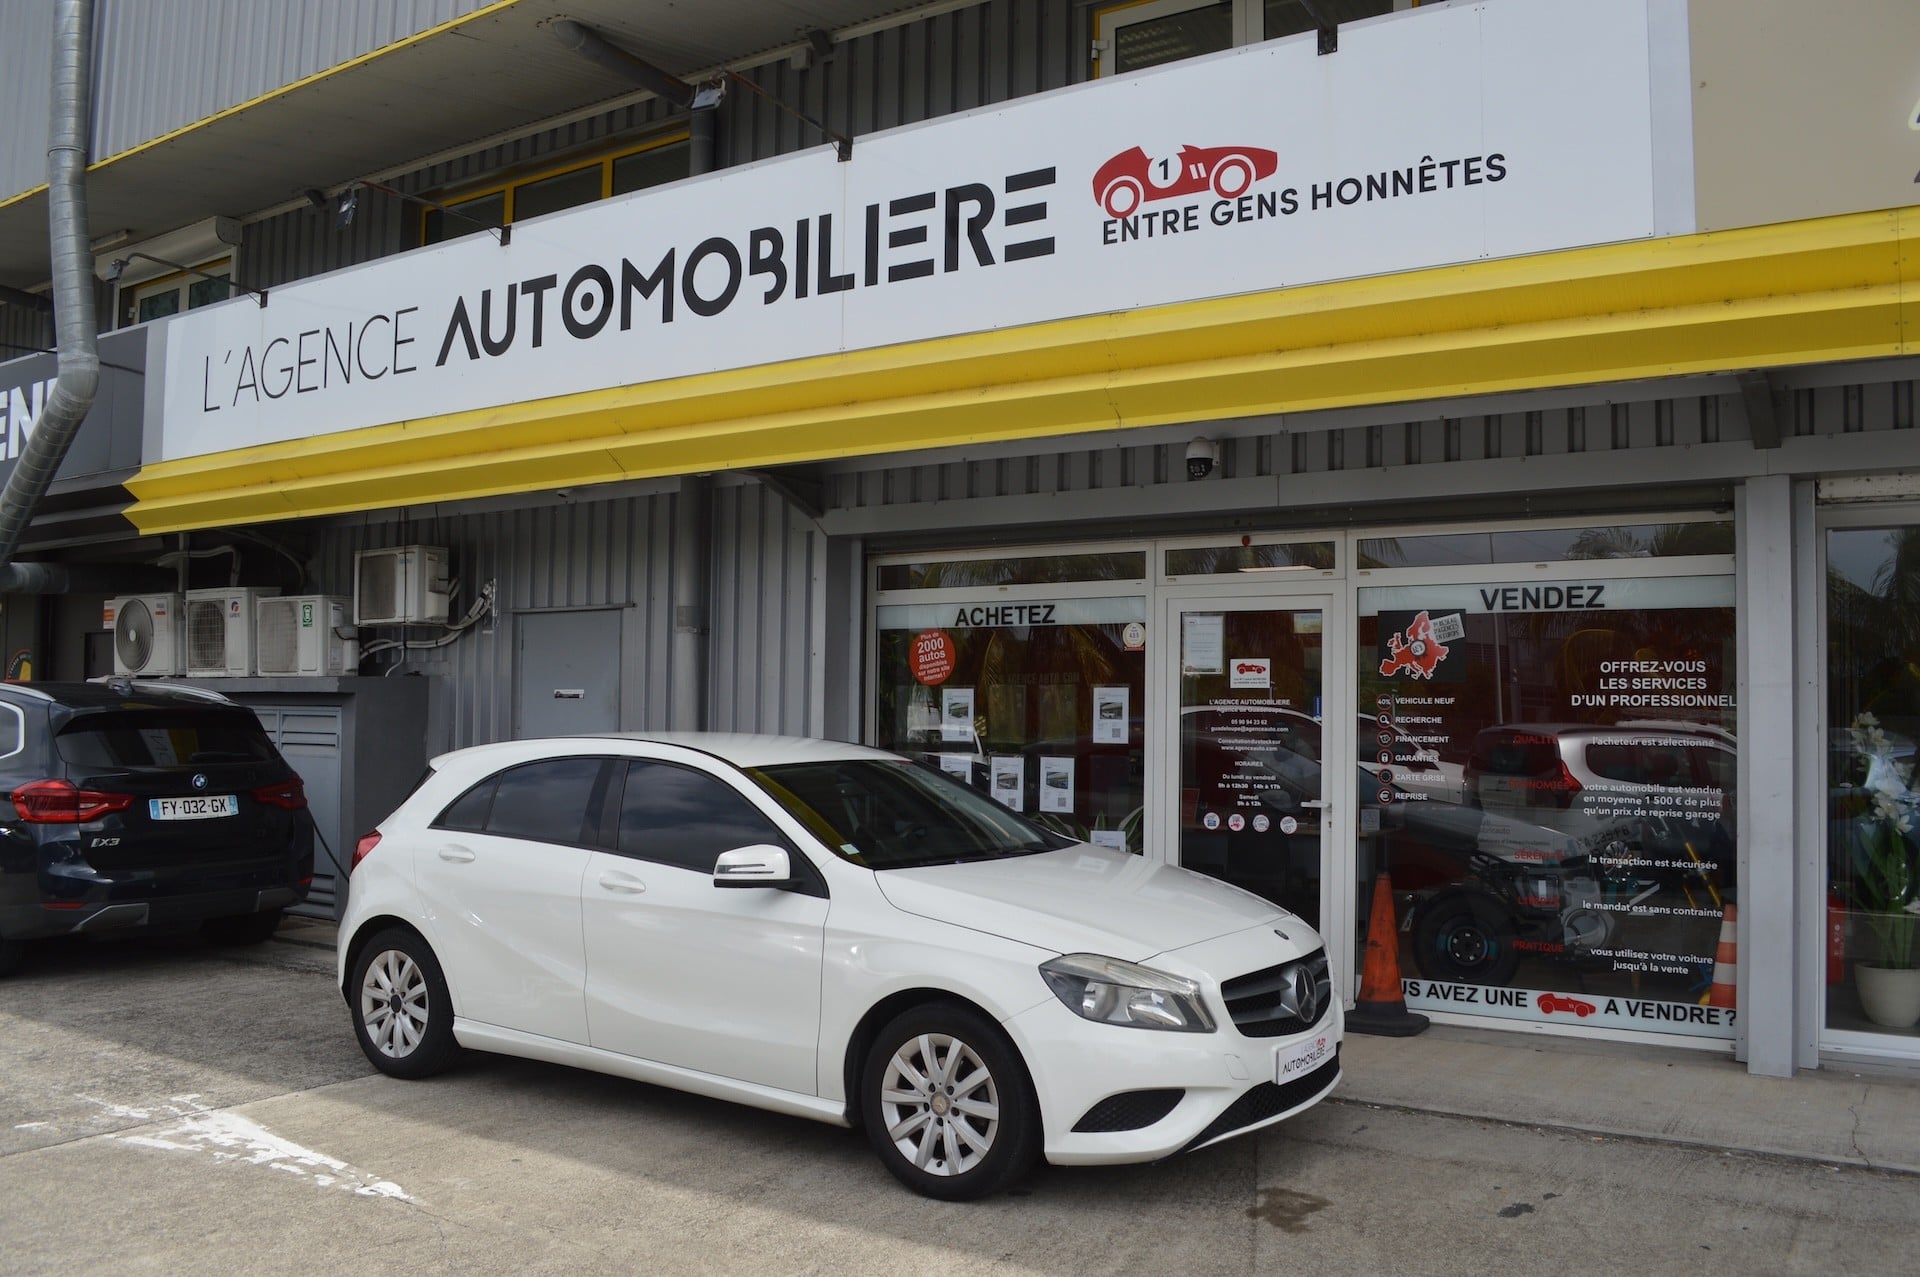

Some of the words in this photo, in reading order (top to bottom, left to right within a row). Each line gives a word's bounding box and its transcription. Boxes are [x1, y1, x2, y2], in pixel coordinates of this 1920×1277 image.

[1103, 204, 1201, 246] ENTRE
[1210, 188, 1299, 226] GENS
[1311, 153, 1508, 212] HONNÊTES
[436, 166, 1056, 368] AUTOMOBILIERE
[1480, 585, 1605, 611] VENDEZ
[955, 604, 1056, 627] ACHETEZ
[917, 637, 944, 655] 2000
[919, 650, 946, 663] autos
[1600, 660, 1707, 673] OFFREZ-VOUS
[1599, 677, 1629, 690] LES
[1631, 677, 1707, 690] SERVICES
[1395, 697, 1433, 705] VEHICULE
[1434, 697, 1456, 705] NEUF
[1609, 694, 1737, 707] PROFESSIONNEL
[1395, 716, 1443, 724] RECHERCHE
[1395, 735, 1450, 744] FINANCEMENT
[1640, 738, 1656, 747] est
[1658, 737, 1715, 748] sélectionné
[1395, 754, 1440, 763] GARANTIES
[1395, 774, 1421, 782] CARTE
[1422, 774, 1446, 782] GRISE
[1583, 784, 1608, 792] votre
[1609, 784, 1665, 793] automobile
[1685, 786, 1722, 795] vendue
[1395, 792, 1428, 801] REPRISE
[1597, 796, 1642, 806] moyenne
[1653, 796, 1673, 806] 500
[1675, 797, 1683, 806] €
[1684, 797, 1698, 806] de
[1699, 798, 1721, 809] plus
[161, 799, 227, 816] FY-032-GX
[1612, 809, 1632, 818] prix
[1633, 808, 1647, 817] de
[1648, 808, 1683, 820] reprise
[1684, 810, 1721, 821] garage
[1588, 854, 1598, 864] la
[1599, 856, 1653, 869] transaction
[1654, 859, 1670, 867] est
[1671, 860, 1718, 870] sécurisée
[1582, 900, 1592, 909] le
[1593, 902, 1631, 912] mandat
[1632, 904, 1649, 912] est
[1672, 907, 1723, 918] contrainte
[1590, 948, 1614, 957] vous
[1614, 949, 1649, 960] utilisez
[1650, 952, 1676, 961] votre
[1677, 954, 1713, 965] voiture
[1649, 963, 1660, 973] la
[1661, 965, 1689, 975] vente
[1426, 983, 1479, 1004] AVEZ
[1484, 988, 1528, 1008] UNE
[1604, 999, 1619, 1015] A
[1626, 1000, 1720, 1025] VENDRE
